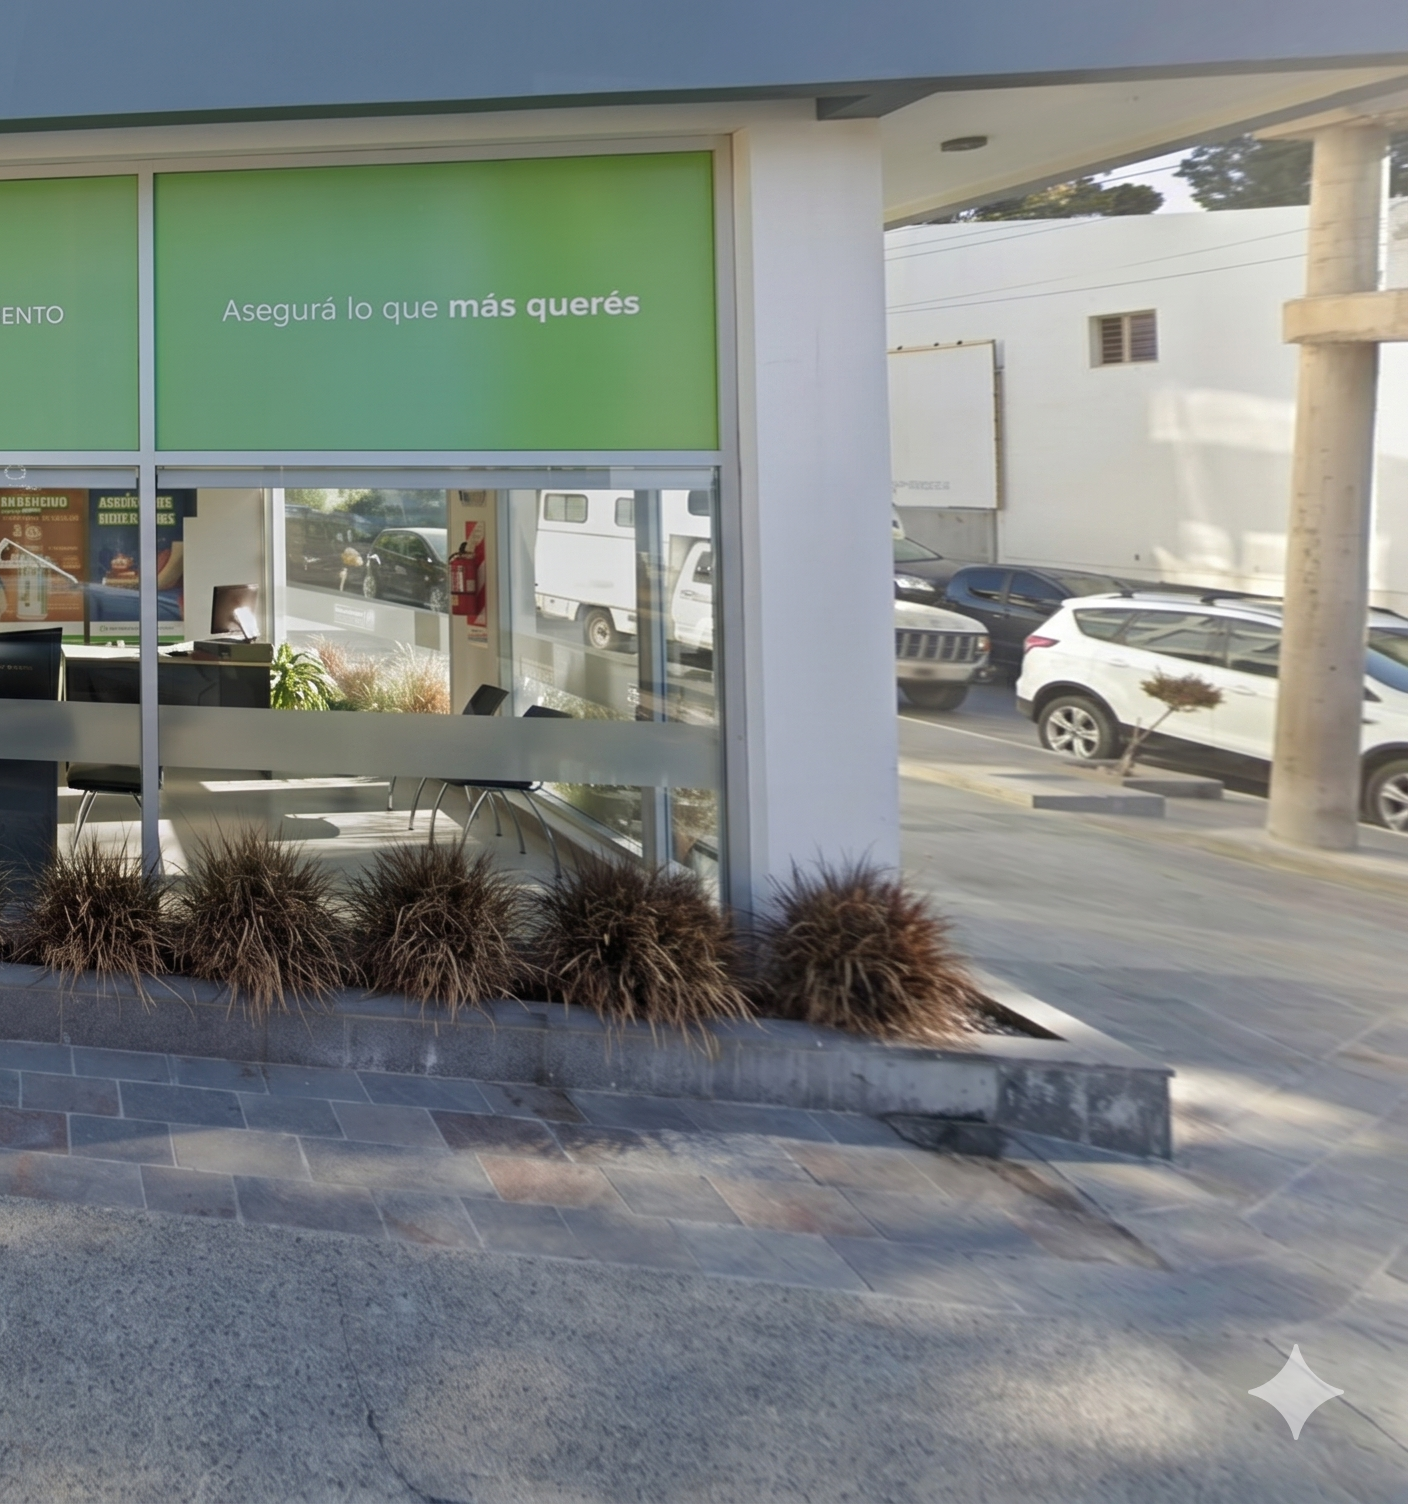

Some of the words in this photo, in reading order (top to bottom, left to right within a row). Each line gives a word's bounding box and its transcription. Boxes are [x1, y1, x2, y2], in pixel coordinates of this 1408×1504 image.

[222, 297, 336, 327] Asegurá
[347, 296, 372, 320] lo
[382, 298, 438, 325] que
[449, 293, 517, 318] más
[526, 290, 641, 323] querés
